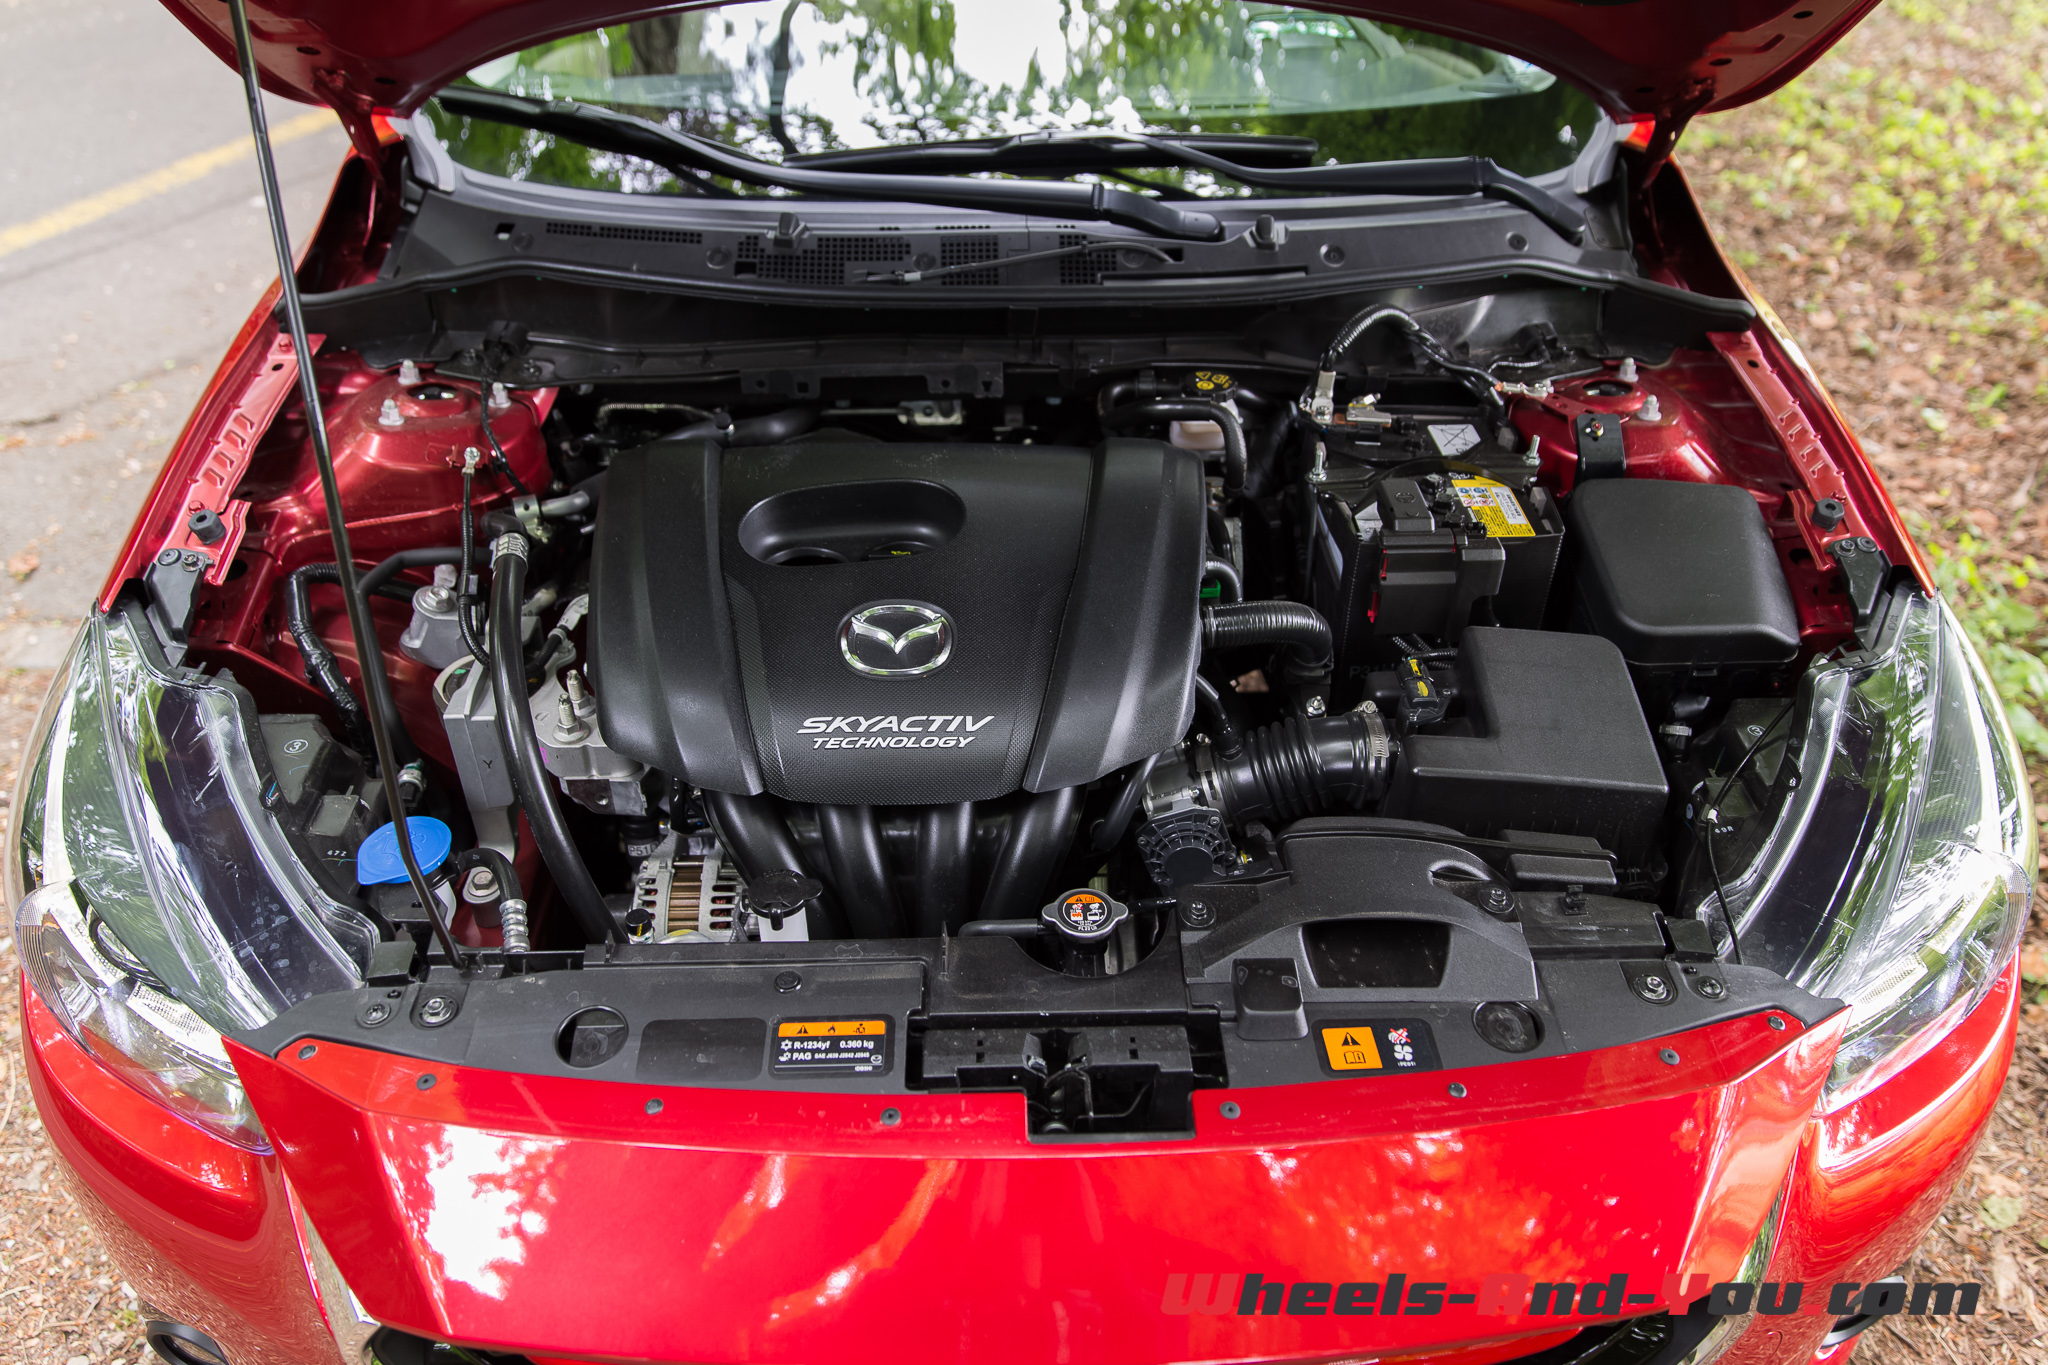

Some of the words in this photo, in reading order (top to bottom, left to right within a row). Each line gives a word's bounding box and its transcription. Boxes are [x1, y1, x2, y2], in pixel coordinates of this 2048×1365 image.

[797, 715, 995, 733] SKYACTIV
[813, 736, 976, 749] TECHNOLOGY
[793, 1040, 831, 1051] R-1234yf
[863, 1039, 875, 1049] kg
[792, 1052, 812, 1061] PAG
